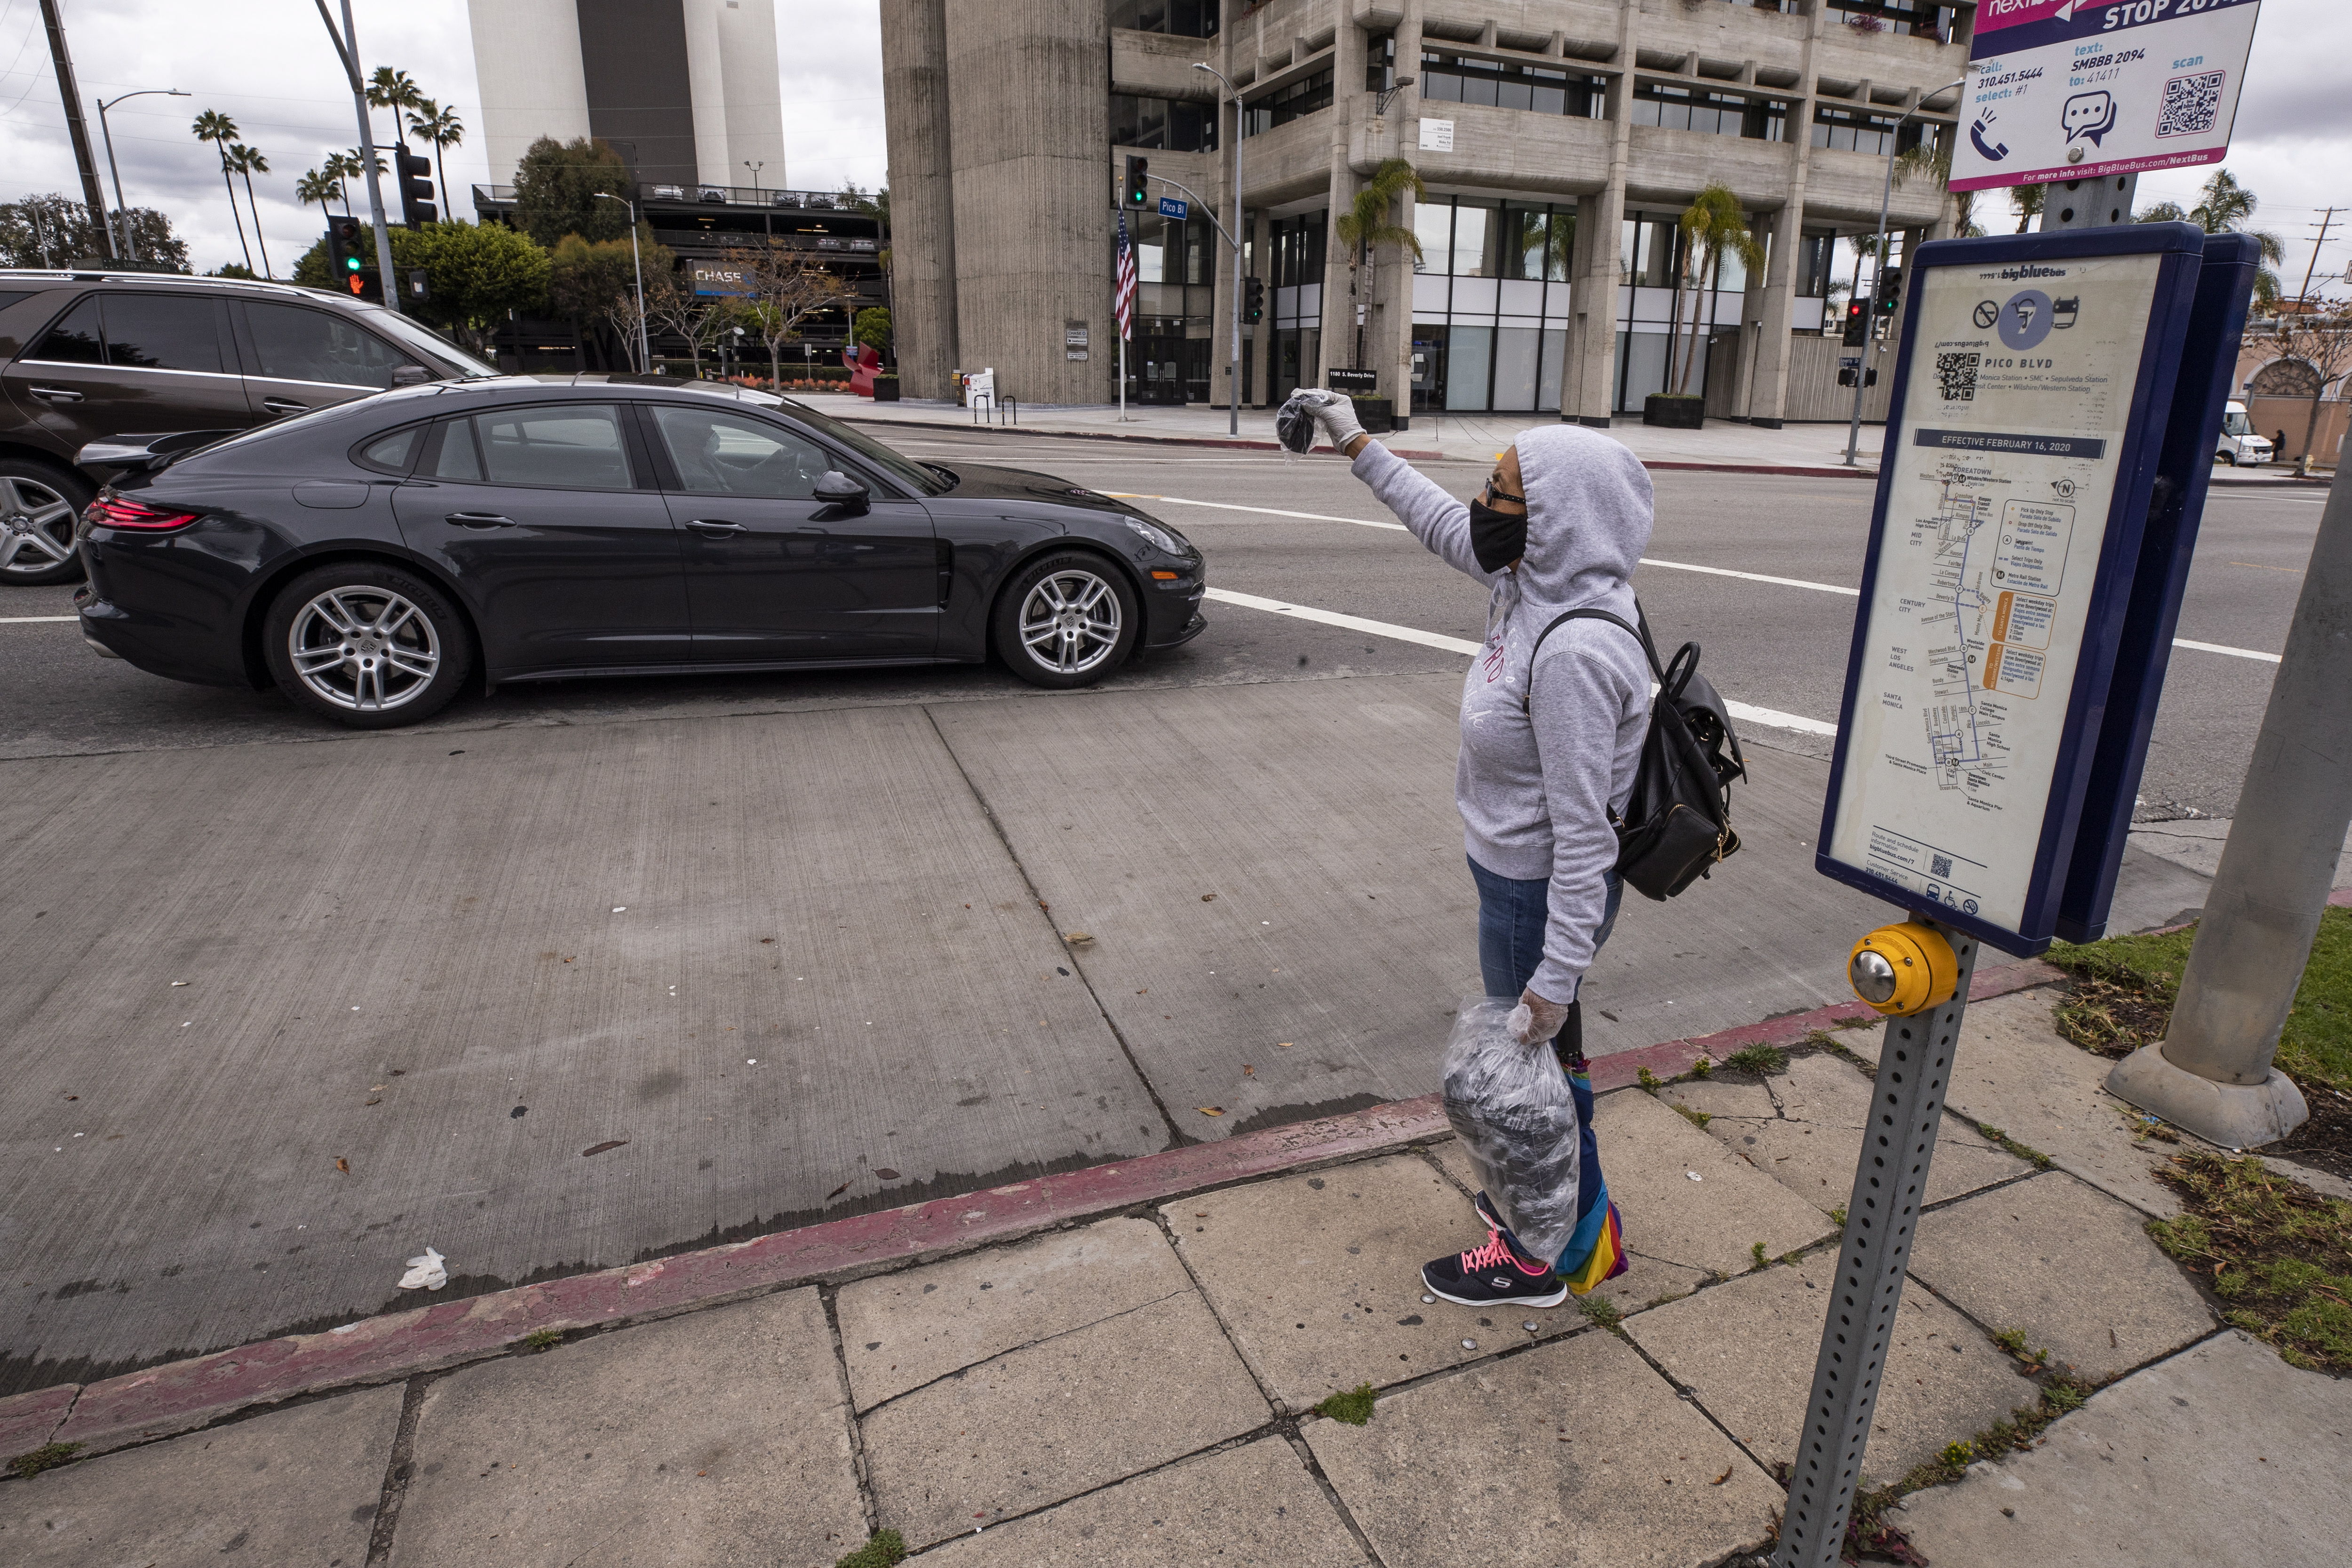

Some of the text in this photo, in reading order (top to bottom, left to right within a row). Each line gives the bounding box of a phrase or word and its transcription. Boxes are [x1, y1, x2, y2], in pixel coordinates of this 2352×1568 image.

[2103, 0, 2169, 29] STOP
[2075, 42, 2103, 56] text:
[2071, 48, 2145, 72] SMBBB 2094
[2172, 56, 2203, 69] scan
[1980, 62, 2002, 74] call:
[1978, 67, 2043, 88] 310.451.5444
[2070, 68, 2120, 86] to: 41411
[1976, 84, 2028, 103] select: #1
[2038, 172, 2058, 180] more
[2098, 154, 2208, 173] BigBlueBus.com/NextBus
[1162, 201, 1176, 213] Pico
[695, 270, 741, 282] CHASE
[1985, 359, 2052, 368] PICO BLVD
[1942, 436, 2070, 452] EFFECTIVE FEBRUARY 16, 2020
[1953, 466, 1991, 475] KOREATOWN
[2062, 484, 2070, 493] N
[1938, 542, 1951, 553] Vicente
[1900, 598, 1925, 608] CENTURY
[1979, 592, 1991, 604] Bagley
[1891, 646, 1907, 654] WEST
[1889, 662, 1914, 672] ANGELES
[1883, 692, 1901, 701] SANTA
[1882, 700, 1903, 709] MONICA
[1989, 712, 2005, 721] Campus
[1907, 760, 1927, 770] Promenade
[1971, 803, 1990, 812] Aquarium
[1871, 837, 1898, 852] information
[1872, 831, 1886, 841] Route
[1897, 842, 1919, 853] schedule
[1869, 844, 1915, 865] bigbluebus.com/7
[1865, 867, 1898, 883] 310.451.5444
[1867, 860, 1908, 880] Customer Service
